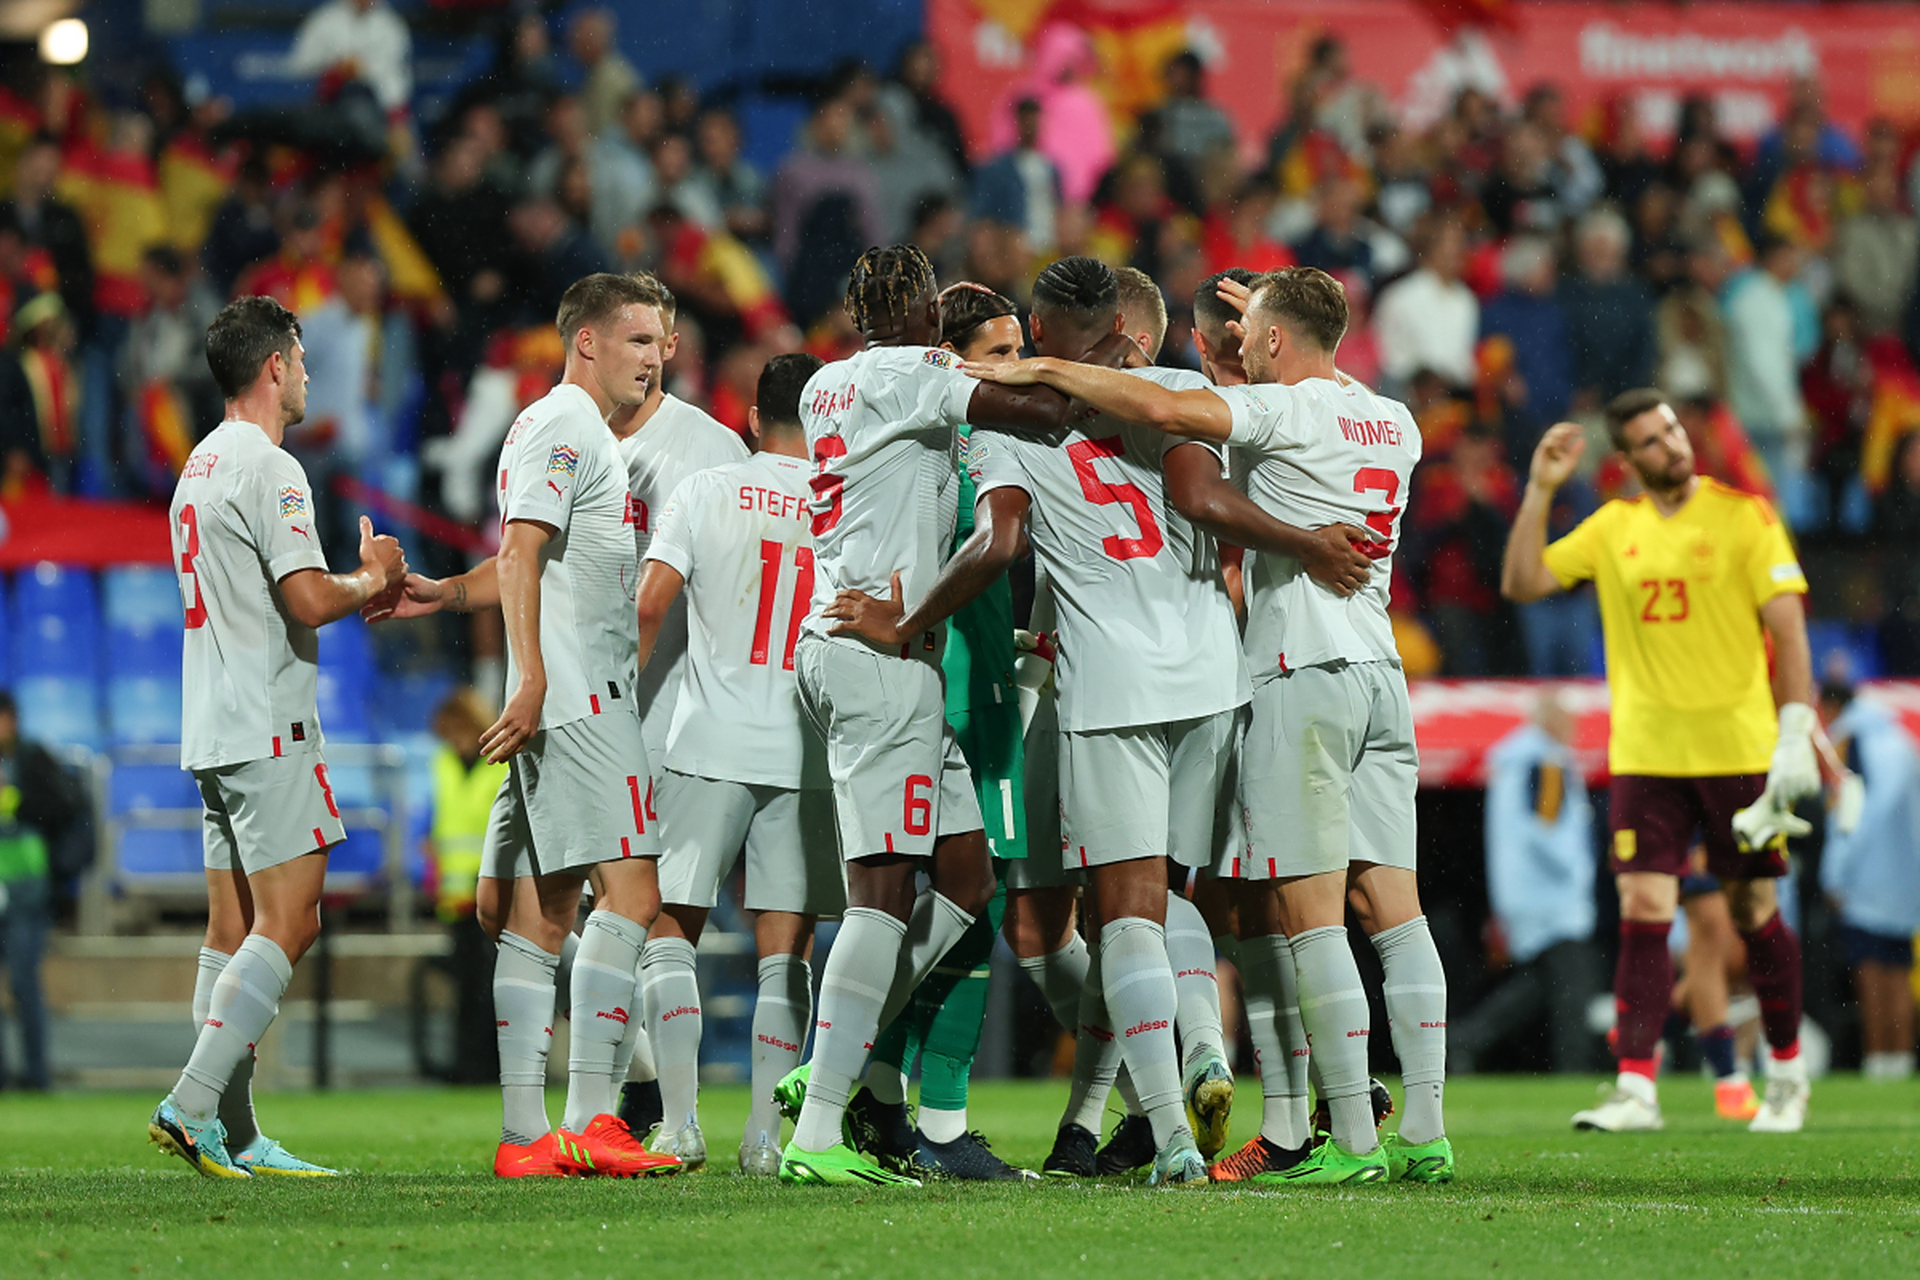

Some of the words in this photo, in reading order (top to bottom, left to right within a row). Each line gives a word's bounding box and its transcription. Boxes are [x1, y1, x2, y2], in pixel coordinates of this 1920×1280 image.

[1066, 435, 1164, 561] 5
[750, 539, 815, 671] 11
[1641, 580, 1688, 622] 23
[904, 774, 933, 836] 6
[999, 779, 1015, 840] 1
[757, 1033, 799, 1053] suisse
[1125, 1019, 1169, 1038] suisse
